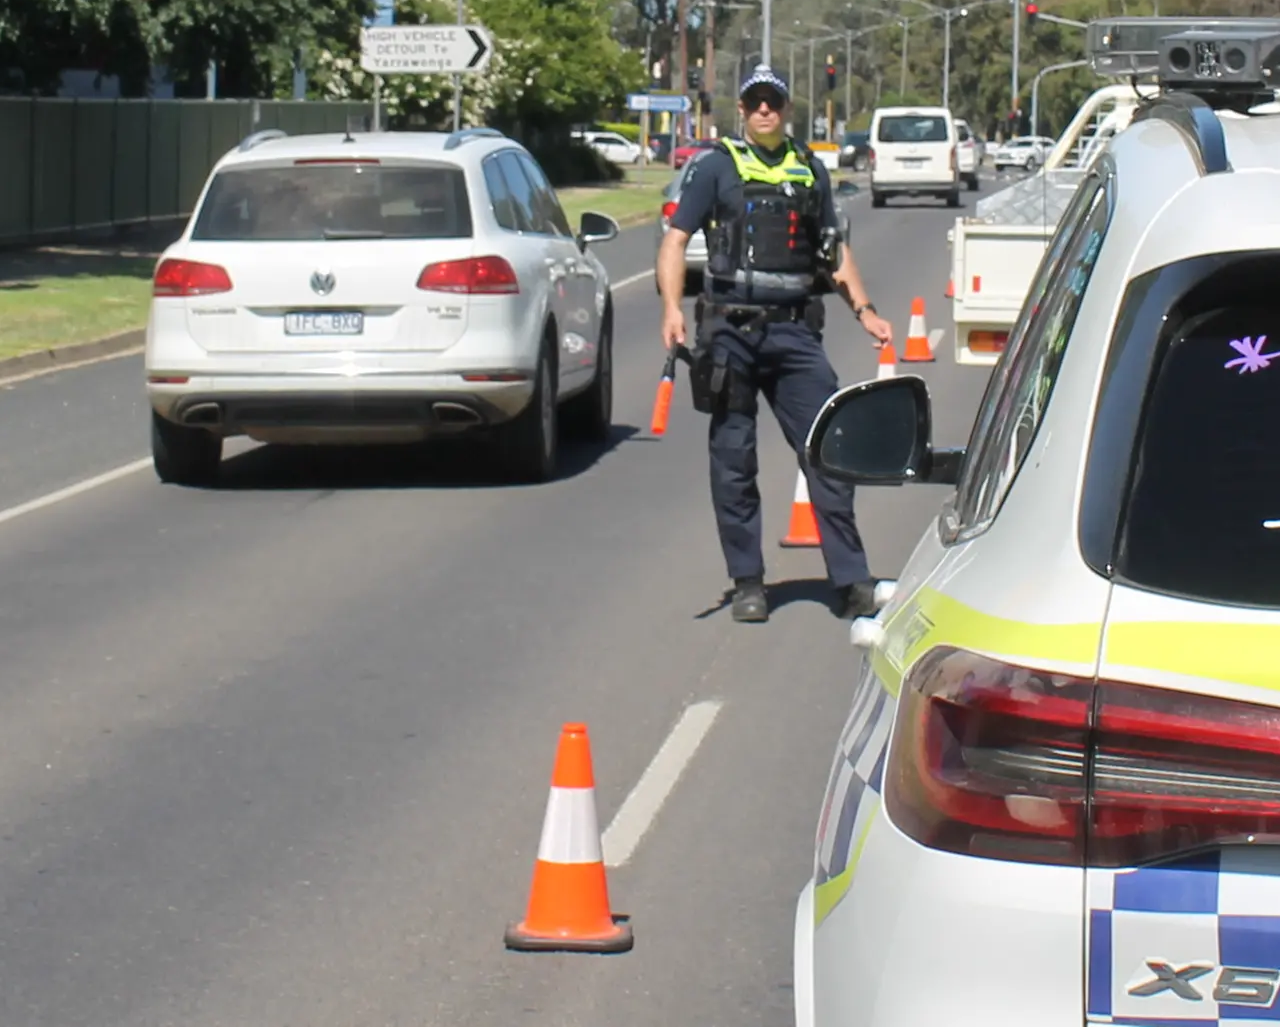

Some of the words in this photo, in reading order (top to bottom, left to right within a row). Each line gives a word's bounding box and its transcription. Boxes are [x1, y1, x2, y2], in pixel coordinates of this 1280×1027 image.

[367, 31, 396, 41] HIGH
[404, 30, 456, 41] VEHICLE
[377, 44, 426, 55] DETOUR
